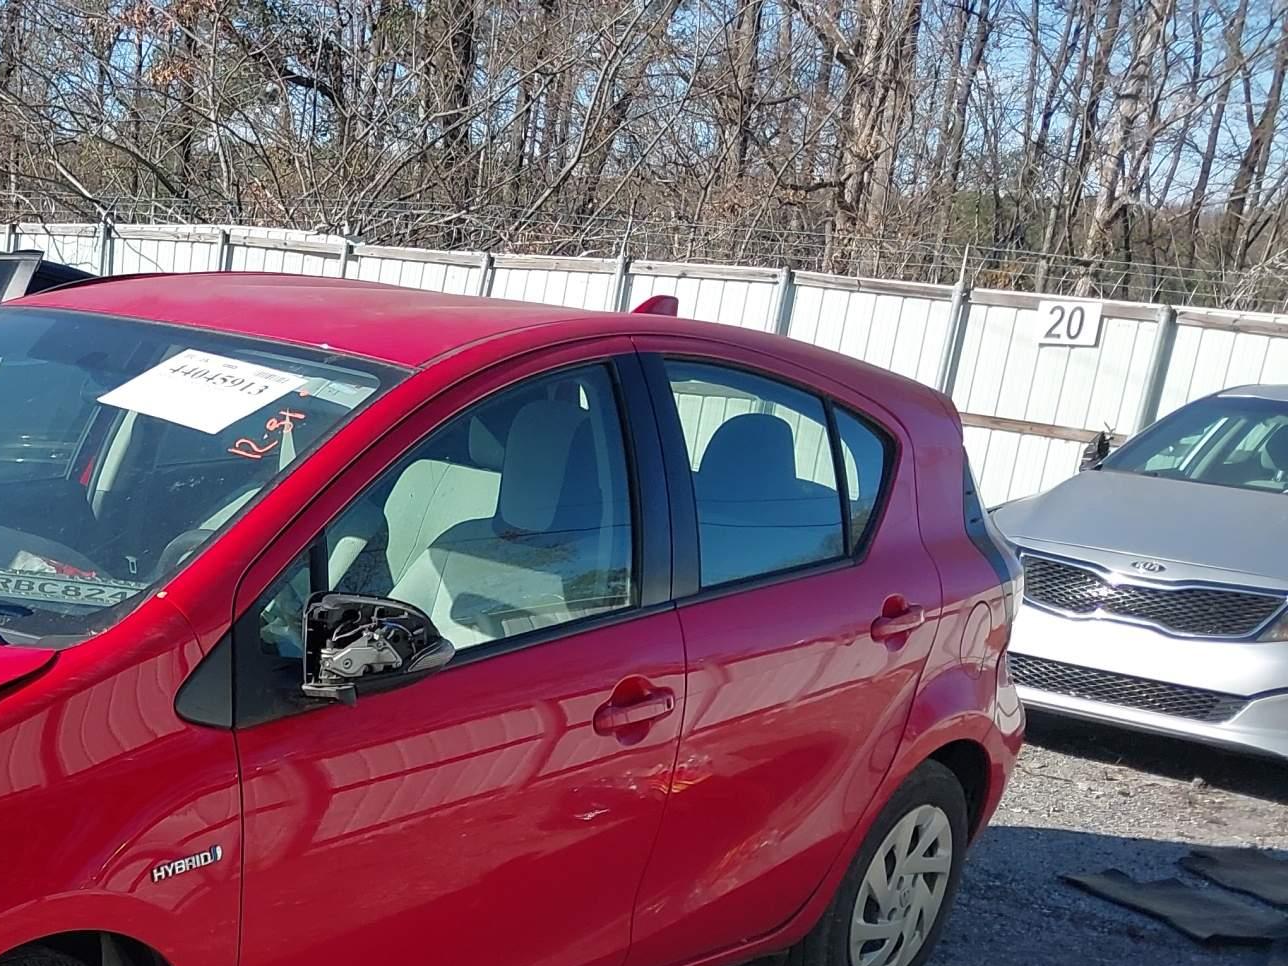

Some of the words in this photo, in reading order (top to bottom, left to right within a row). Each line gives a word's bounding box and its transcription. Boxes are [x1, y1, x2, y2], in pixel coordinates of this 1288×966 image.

[1044, 304, 1085, 340] 20
[169, 364, 269, 395] 44045913
[152, 850, 212, 882] HYBRID
